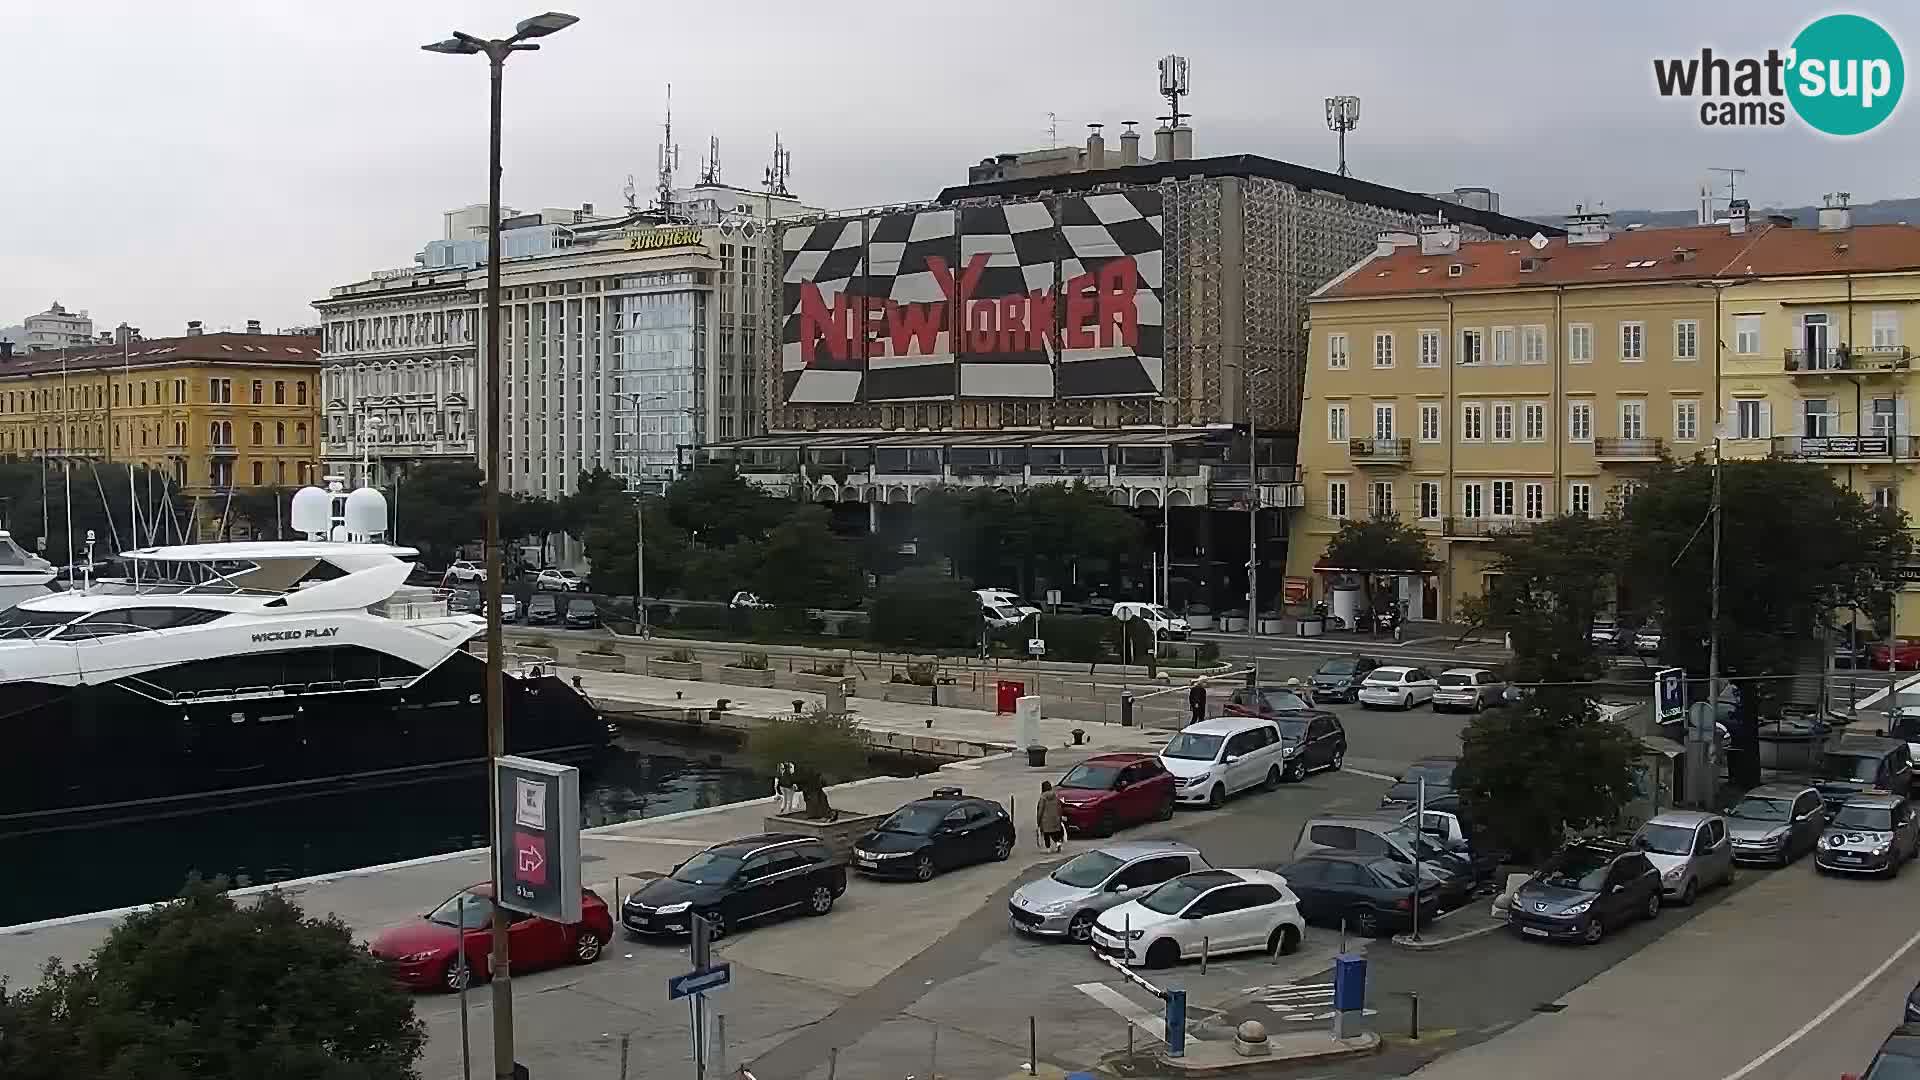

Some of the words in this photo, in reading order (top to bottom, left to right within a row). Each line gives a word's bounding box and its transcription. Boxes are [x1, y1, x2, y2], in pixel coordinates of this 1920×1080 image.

[801, 279, 944, 363] NEW
[925, 252, 1138, 356] YORKER
[251, 630, 301, 642] WICKED
[304, 627, 339, 638] PLAY
[1666, 677, 1677, 699] P
